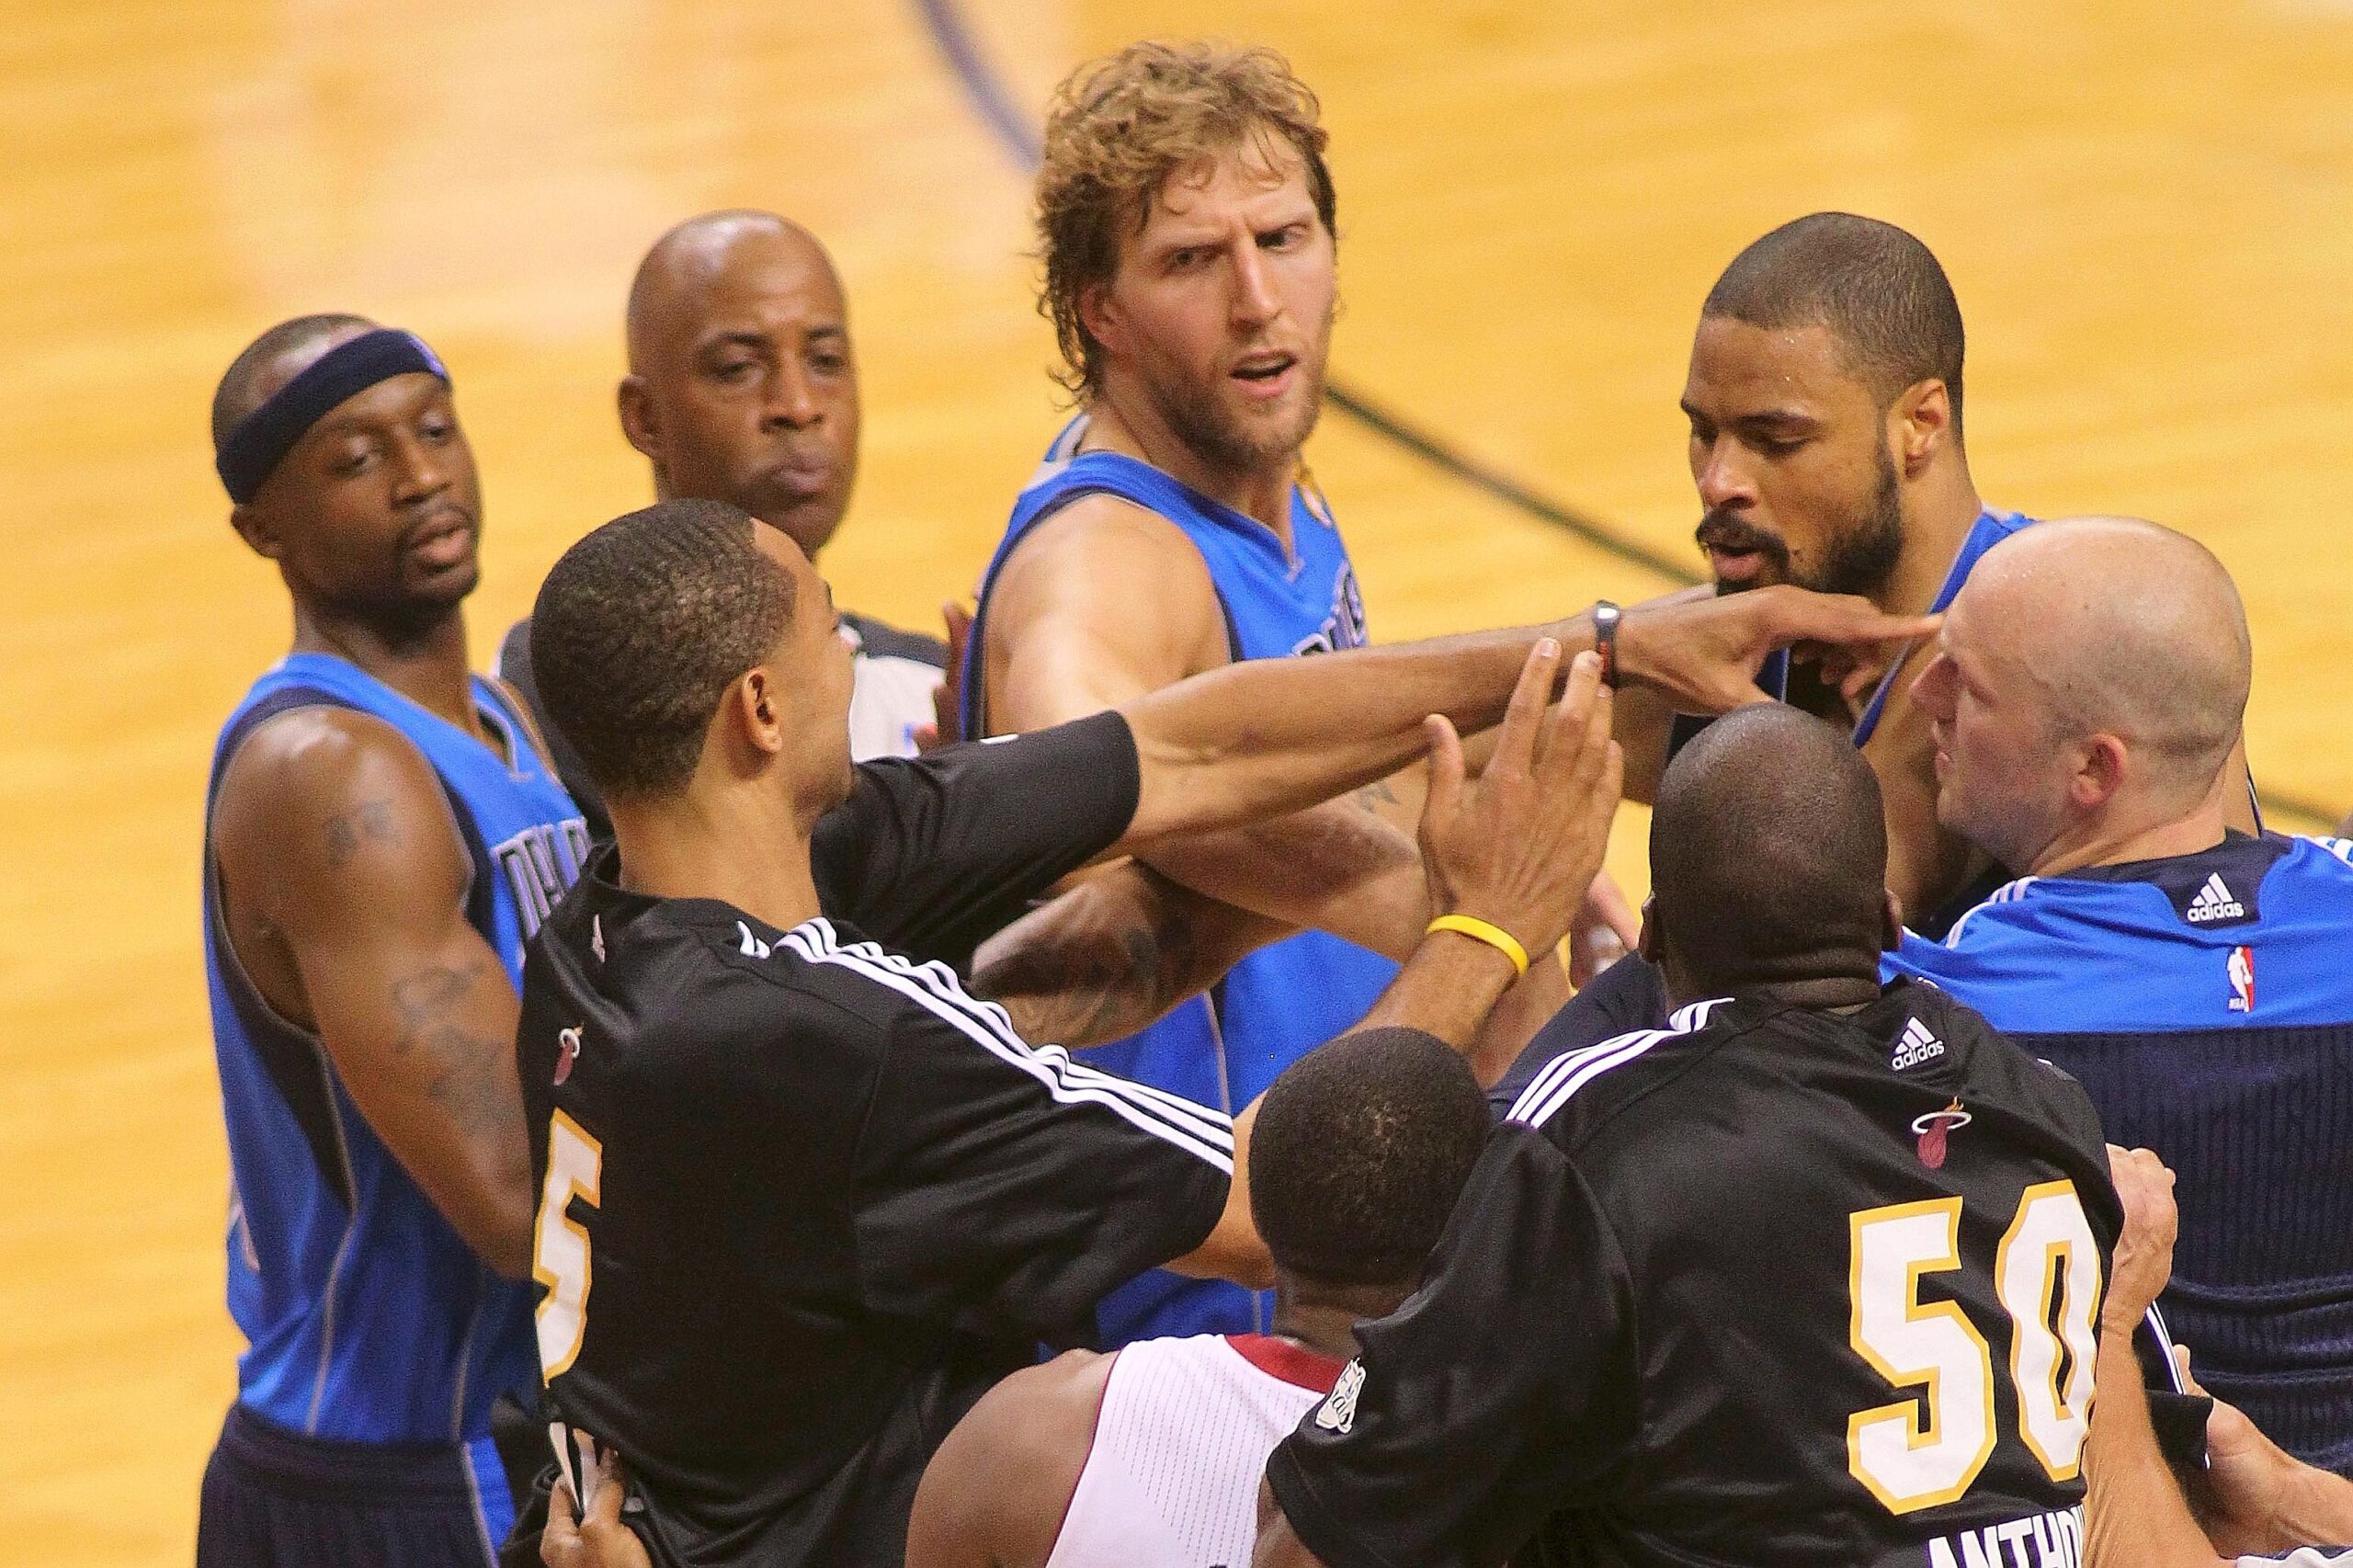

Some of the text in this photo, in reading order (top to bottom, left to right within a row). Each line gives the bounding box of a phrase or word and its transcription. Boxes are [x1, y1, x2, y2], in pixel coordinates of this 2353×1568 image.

[2187, 901, 2245, 923] adidas
[1892, 1040, 1945, 1071] adidas
[1847, 1178, 2102, 1516] 50
